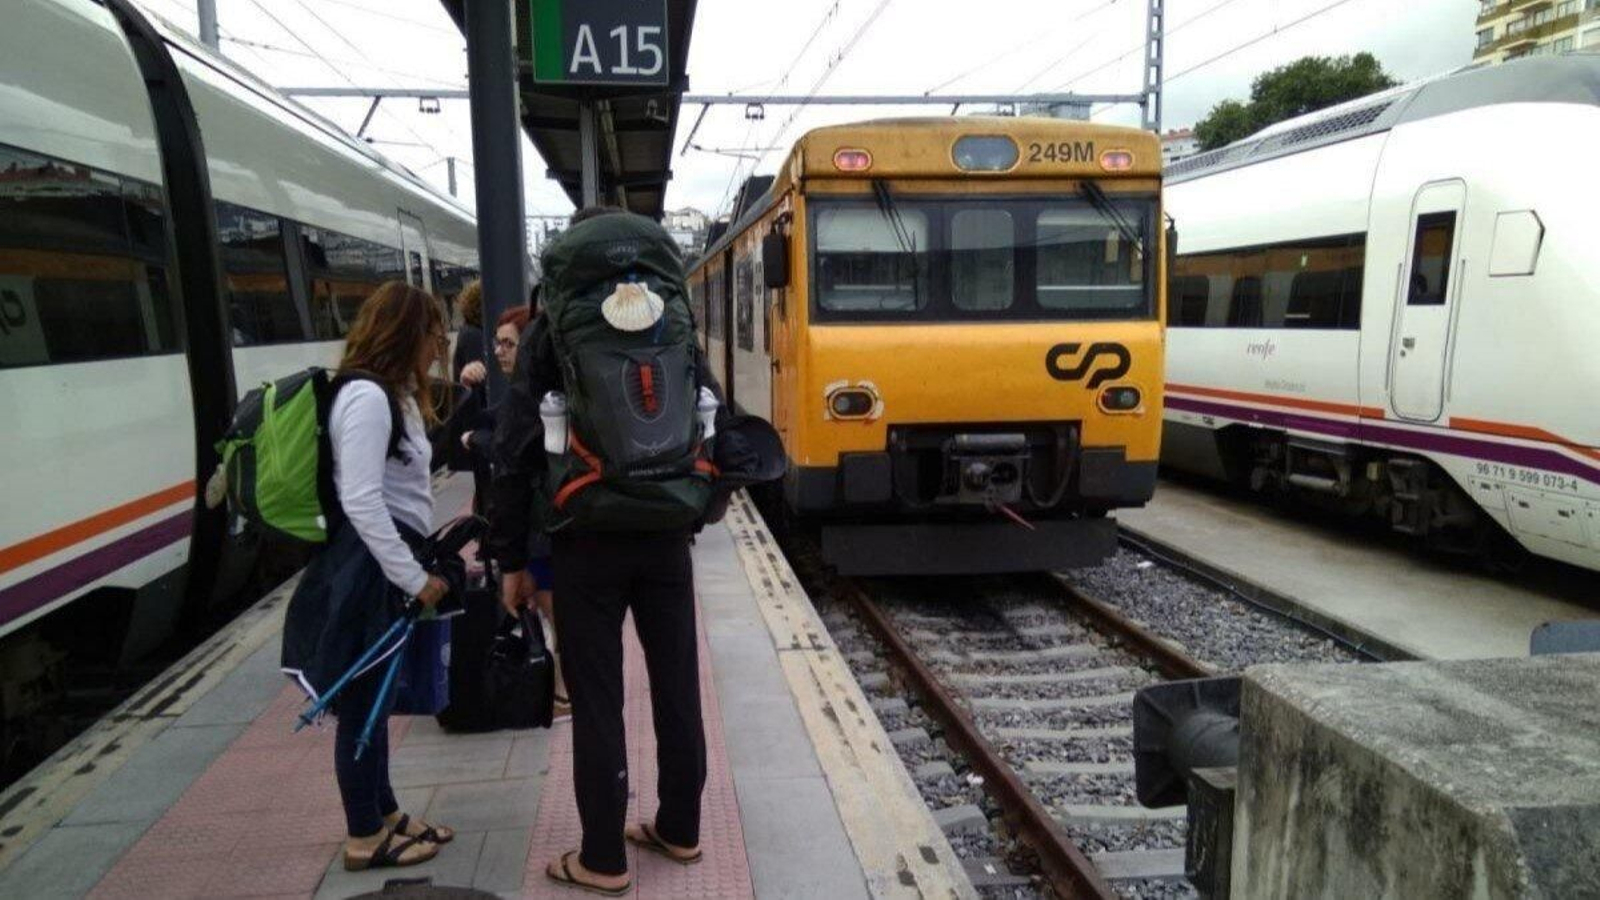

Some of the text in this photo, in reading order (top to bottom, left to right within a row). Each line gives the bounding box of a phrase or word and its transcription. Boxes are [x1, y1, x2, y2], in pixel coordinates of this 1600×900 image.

[570, 24, 663, 76] A 15
[1029, 142, 1094, 162] 249M
[1045, 342, 1131, 390] CP
[1247, 339, 1275, 360] renfe
